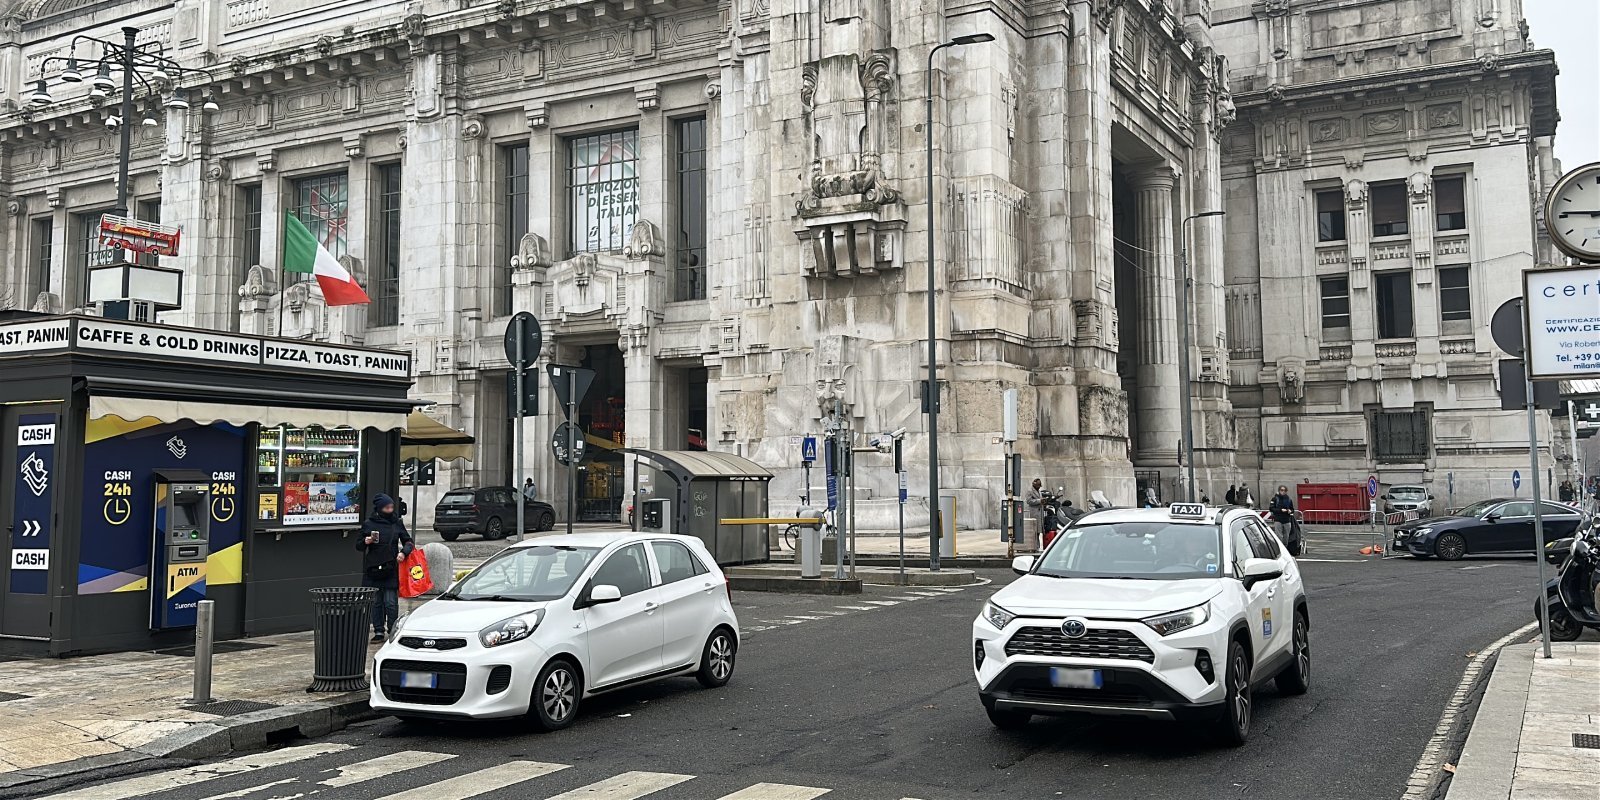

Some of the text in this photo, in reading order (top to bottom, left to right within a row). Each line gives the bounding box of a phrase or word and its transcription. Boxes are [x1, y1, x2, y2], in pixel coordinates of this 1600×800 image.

[588, 192, 639, 207] DI ESSER
[27, 326, 69, 344] PANINI
[79, 326, 259, 356] CAFFE & COLD DRINKS
[265, 346, 407, 371] PIZZA, TOAST, PANINI
[1556, 354, 1572, 362] Tel.
[1574, 353, 1592, 361] +39
[21, 427, 52, 441] CASH
[104, 470, 132, 481] CASH
[212, 471, 236, 481] CASH
[103, 482, 132, 496] 24h
[211, 482, 236, 495] 24h
[1172, 505, 1201, 514] TAXI
[15, 552, 46, 566] CASH
[176, 567, 198, 578] ATM
